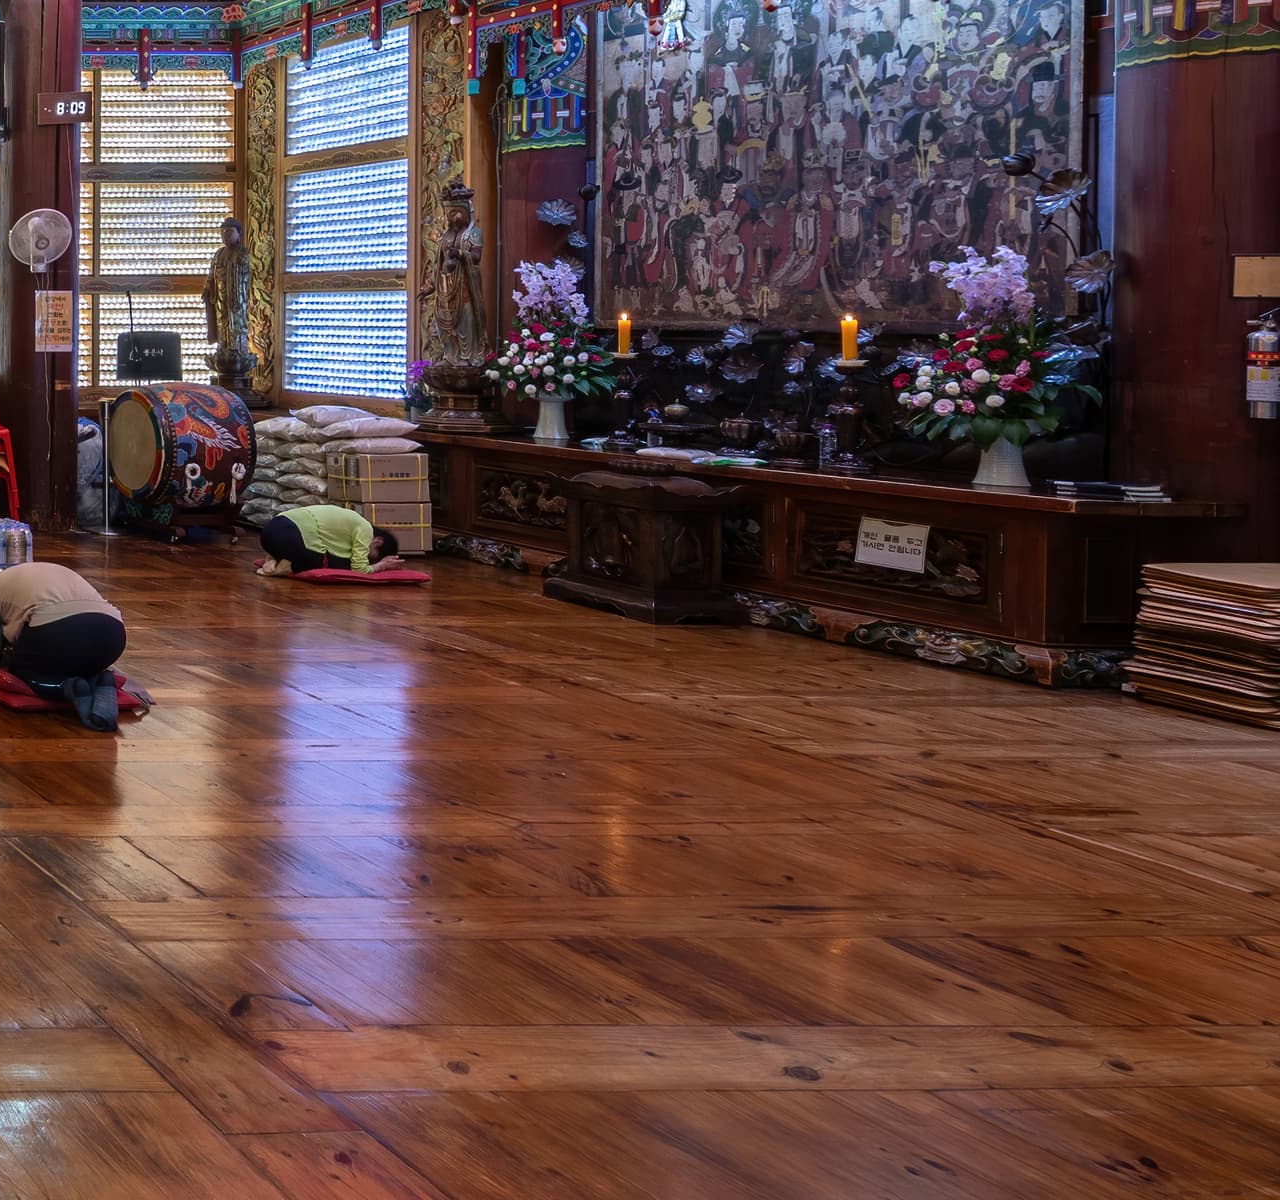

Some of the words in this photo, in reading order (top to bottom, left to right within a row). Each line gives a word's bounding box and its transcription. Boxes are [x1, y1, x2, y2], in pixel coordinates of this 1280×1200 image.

[56, 101, 86, 115] 8:09
[860, 540, 885, 551] 가시면
[888, 544, 921, 556] 안됩니다
